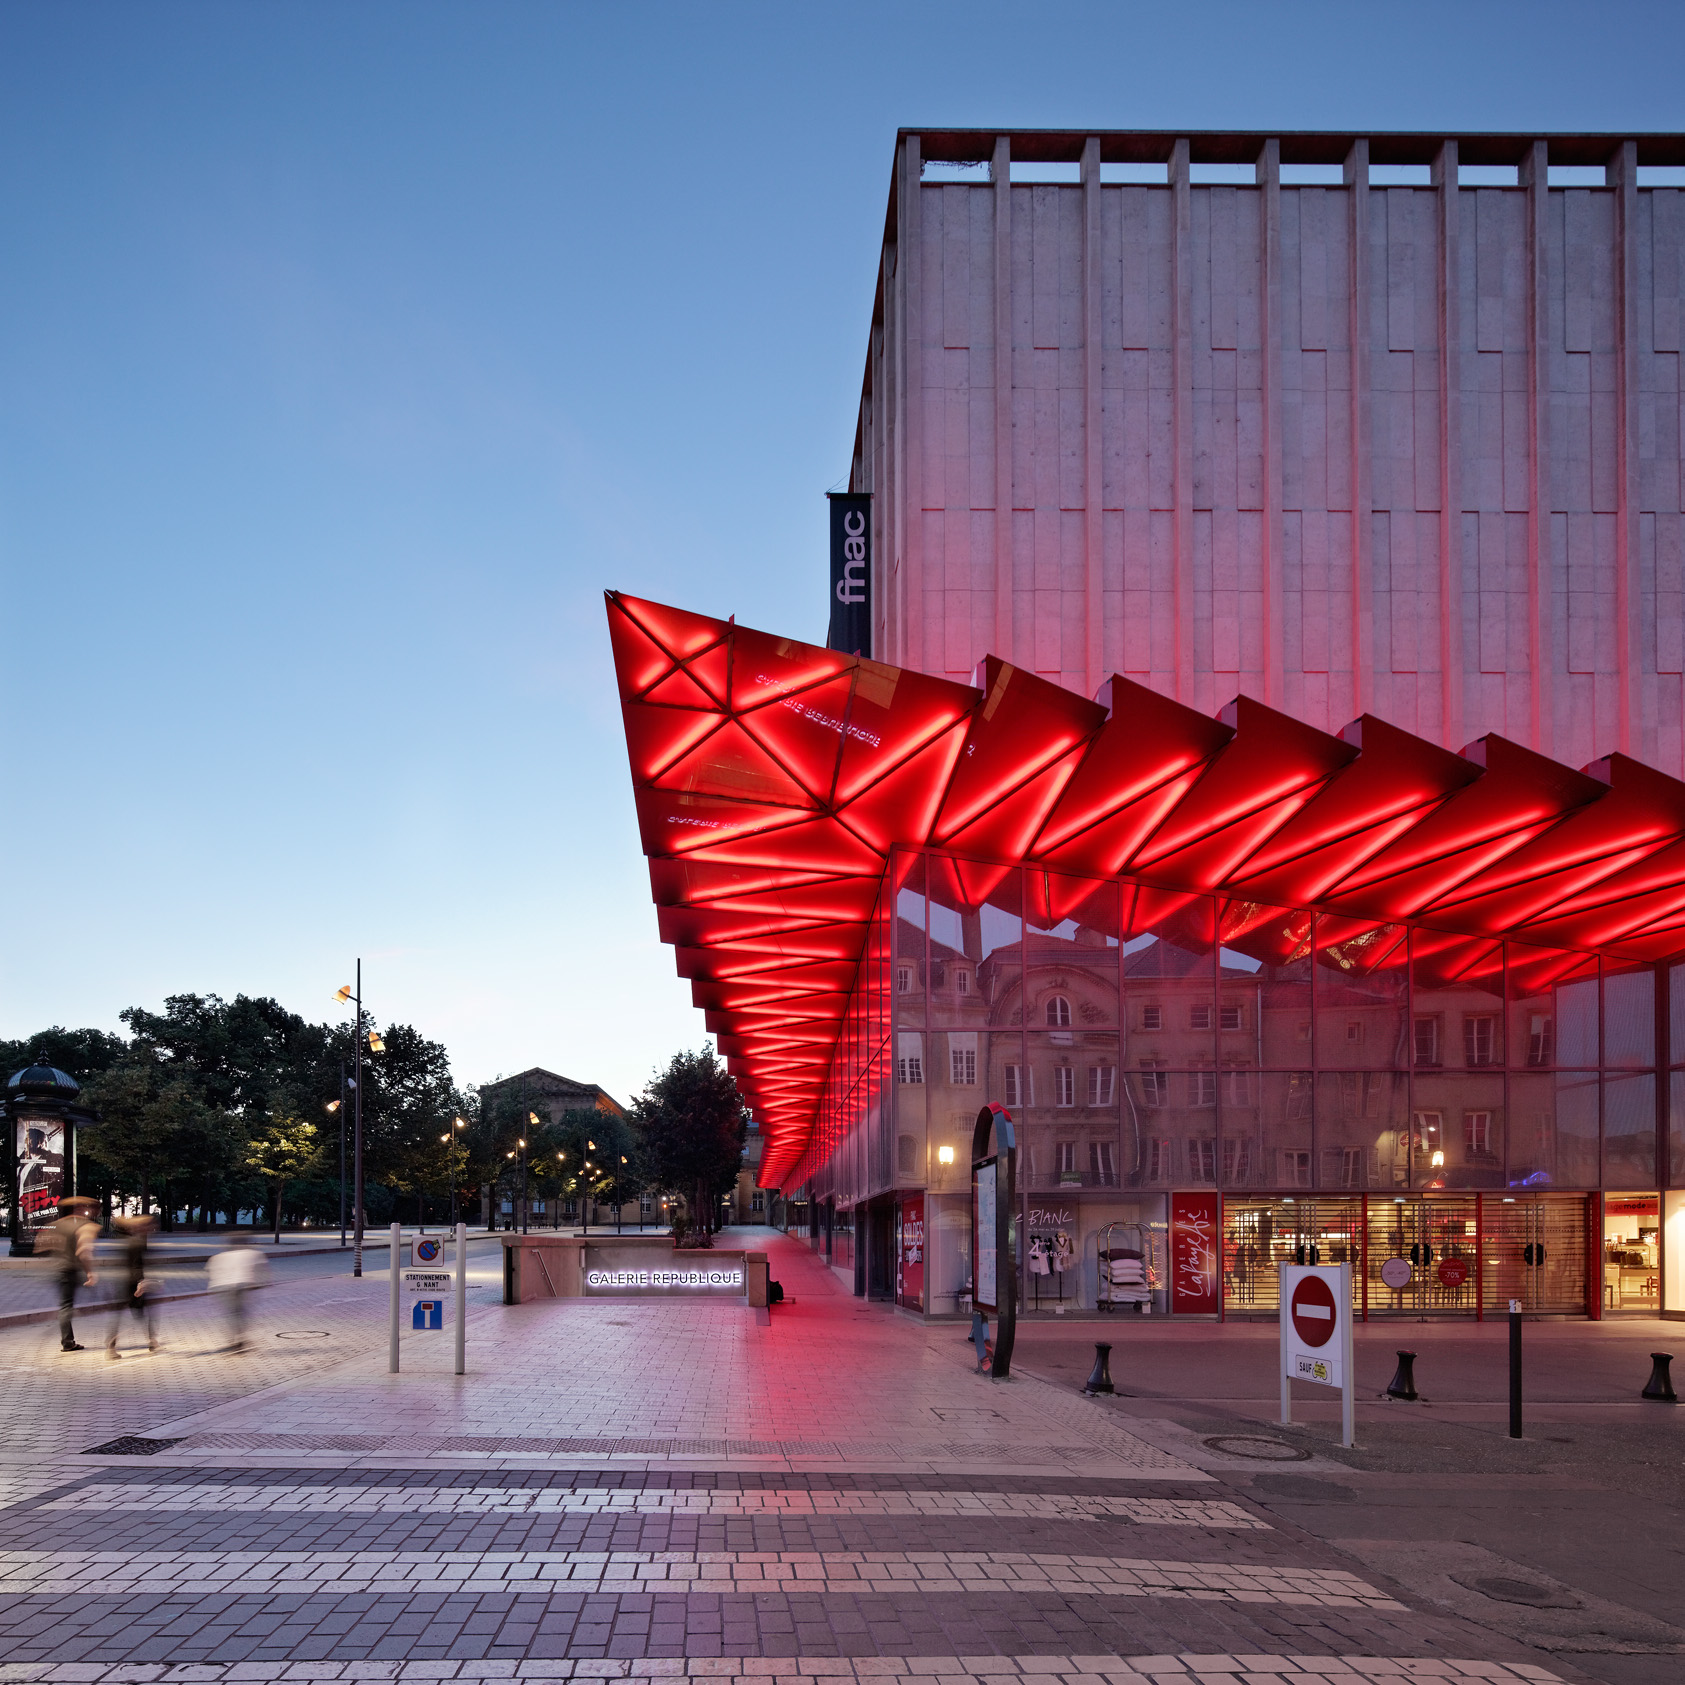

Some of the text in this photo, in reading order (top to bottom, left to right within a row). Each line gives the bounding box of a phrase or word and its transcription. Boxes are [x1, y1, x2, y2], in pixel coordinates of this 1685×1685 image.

[836, 510, 866, 605] fnac
[19, 1188, 48, 1207] SIN
[24, 1195, 61, 1214] CITY
[904, 1220, 923, 1246] SOLDES
[1174, 1209, 1216, 1298] Lafayette
[1178, 1209, 1186, 1297] GALERIES
[589, 1273, 741, 1284] GALERIE REPUBLIQUE
[1444, 1271, 1460, 1279] -70%
[1299, 1361, 1312, 1374] SAUF
